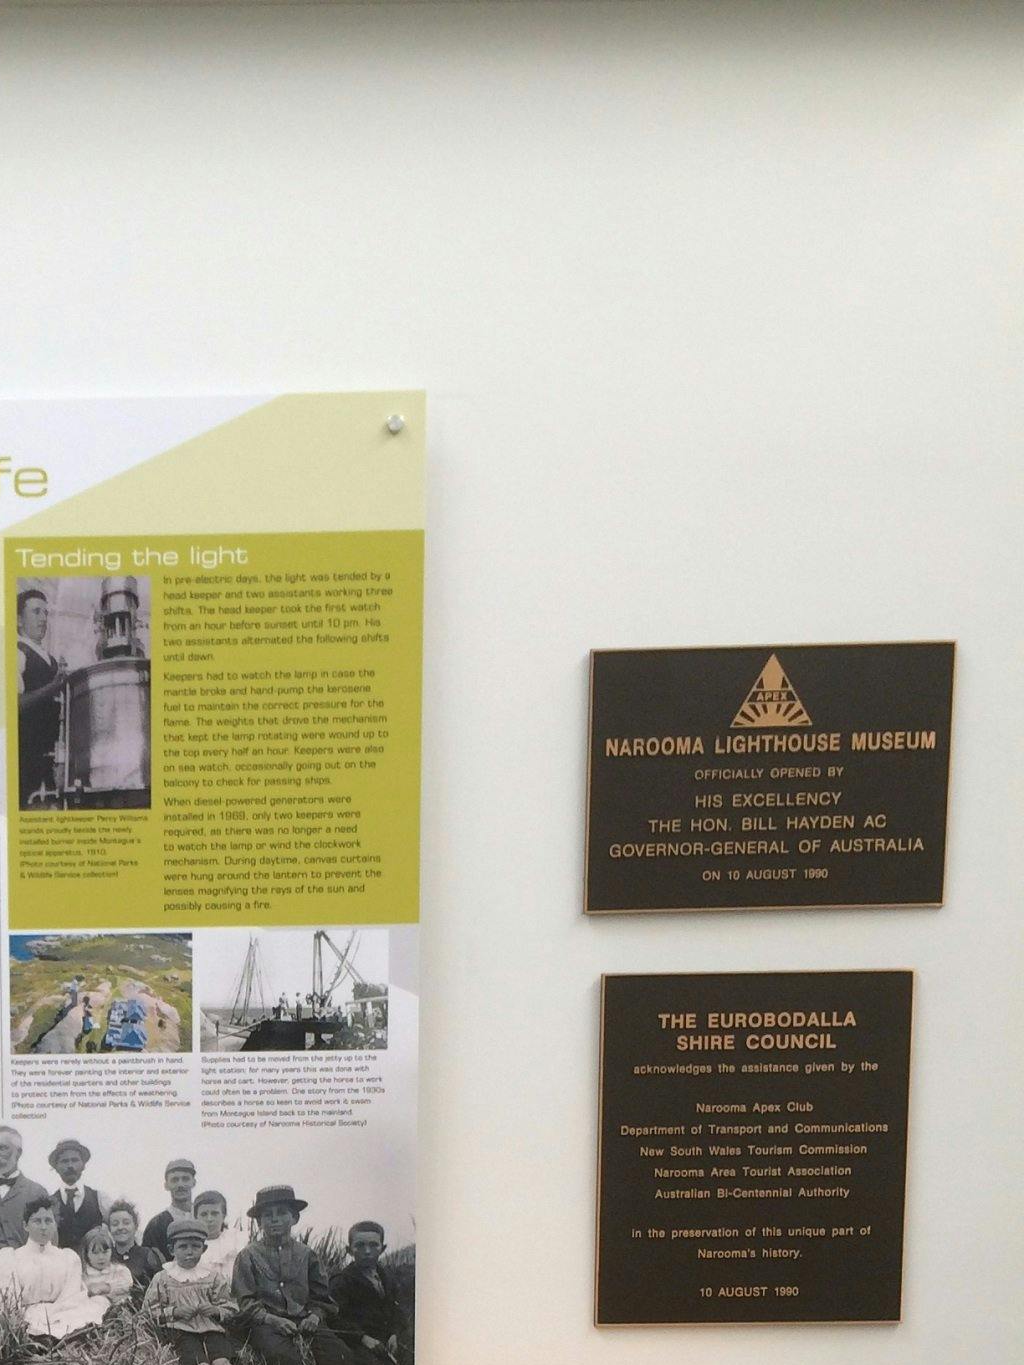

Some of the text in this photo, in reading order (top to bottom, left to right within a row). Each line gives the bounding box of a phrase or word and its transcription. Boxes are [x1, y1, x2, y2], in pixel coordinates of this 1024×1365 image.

[15, 546, 248, 570] Tending the light
[756, 690, 788, 702] APEX
[606, 731, 936, 756] NAROOMA LIGHTHOUSE MUSEUM
[694, 764, 845, 781] OFFICIALLY OPENED BY
[695, 791, 842, 809] HIS EXCELLENCY
[647, 813, 887, 833] THE HON. BILL HAYDEN AC
[610, 837, 925, 858] GOVERNOR-GENERAL OF AUSTRALIA
[702, 867, 829, 881] ON 10 AUGUST 1990
[657, 1011, 856, 1029] THE EUROBODALLA
[676, 1033, 837, 1051] SHIRE COUNCIL
[633, 1060, 879, 1076] acknowledges the assistance given by the
[695, 1101, 814, 1115] Narooma Apex Club
[620, 1121, 889, 1138] Department of Transport and Communications
[639, 1143, 868, 1157] New South Wales Tourism Commission
[653, 1165, 852, 1178] Narooma Area Tourist Association
[654, 1186, 851, 1199] Australian Bi-Centennial Authority
[631, 1225, 871, 1240] in the preservation of this unique part of
[697, 1247, 803, 1260] Narooma's history.
[699, 1285, 799, 1298] 10 AUGUST 1990
